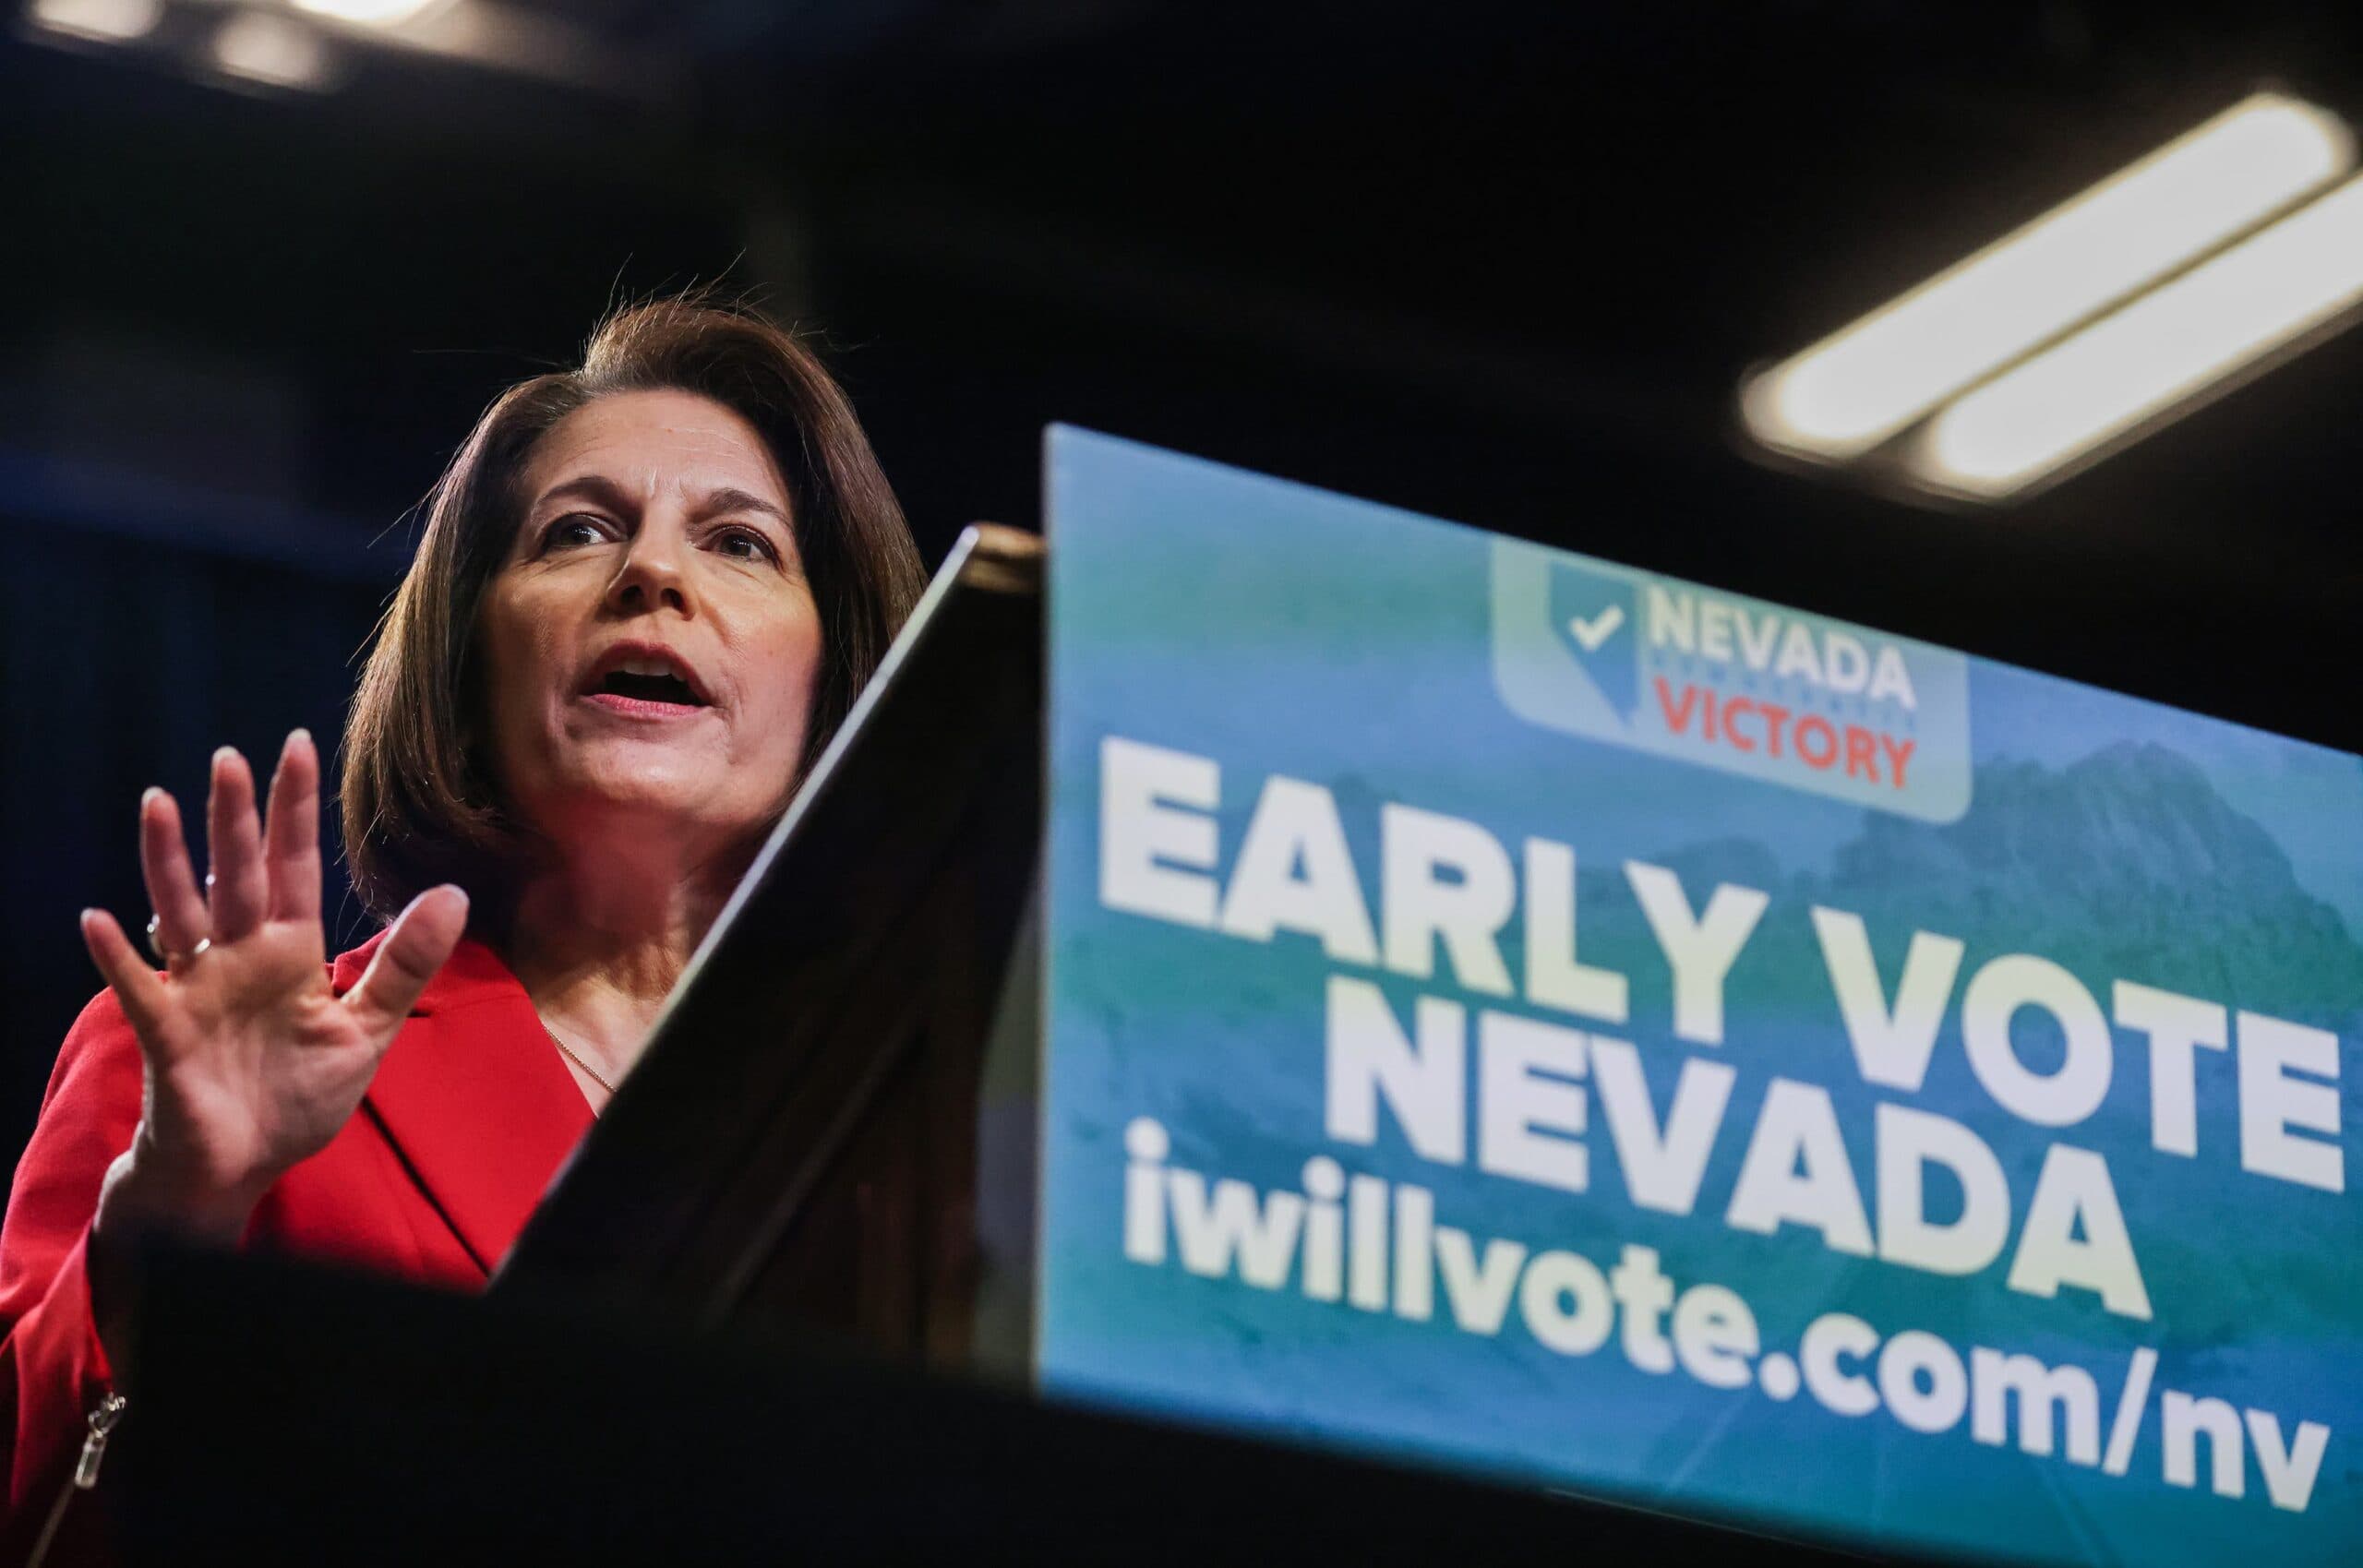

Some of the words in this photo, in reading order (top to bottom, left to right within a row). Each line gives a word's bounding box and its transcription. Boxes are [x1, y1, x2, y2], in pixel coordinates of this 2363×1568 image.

[1649, 585, 1917, 710] NEVADA
[1655, 676, 1915, 788] VICTORY
[1100, 736, 1769, 1046] EARLY
[1810, 905, 2345, 1193] VOTE
[1124, 1117, 2331, 1513] iwillvote.com/nv
[1324, 975, 2153, 1323] NEVADA
